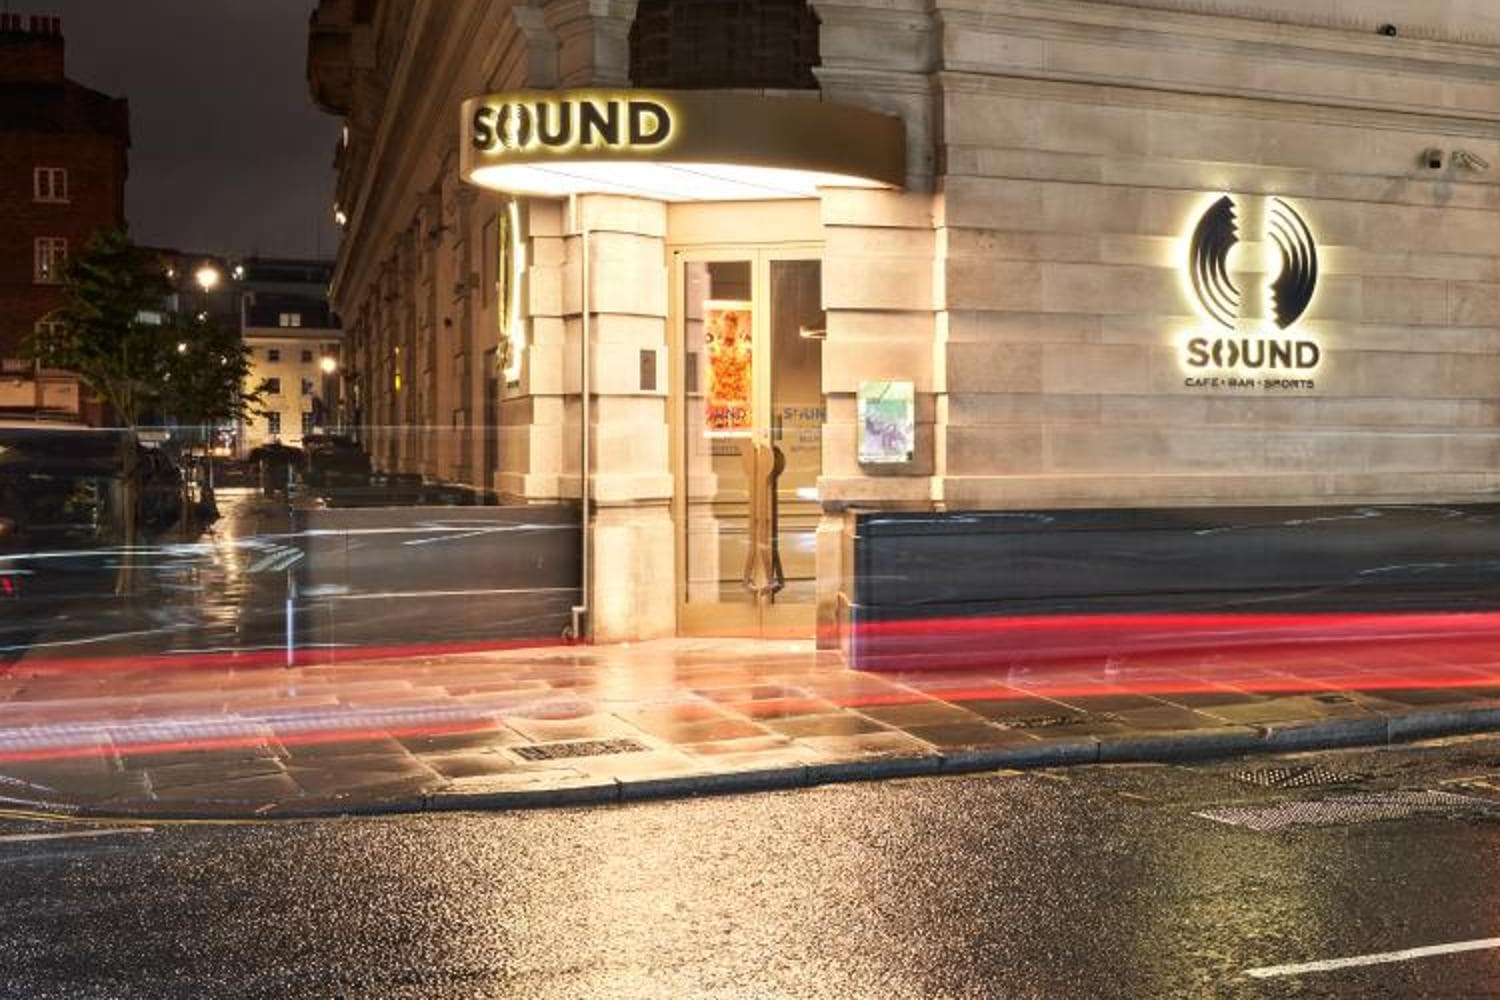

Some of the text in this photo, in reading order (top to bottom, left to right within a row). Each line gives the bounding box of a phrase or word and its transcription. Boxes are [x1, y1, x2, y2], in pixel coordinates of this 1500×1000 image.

[472, 100, 671, 148] SOUND
[1187, 337, 1320, 369] SOUND
[1228, 377, 1255, 388] BAR
[1264, 378, 1315, 390] SPORTS
